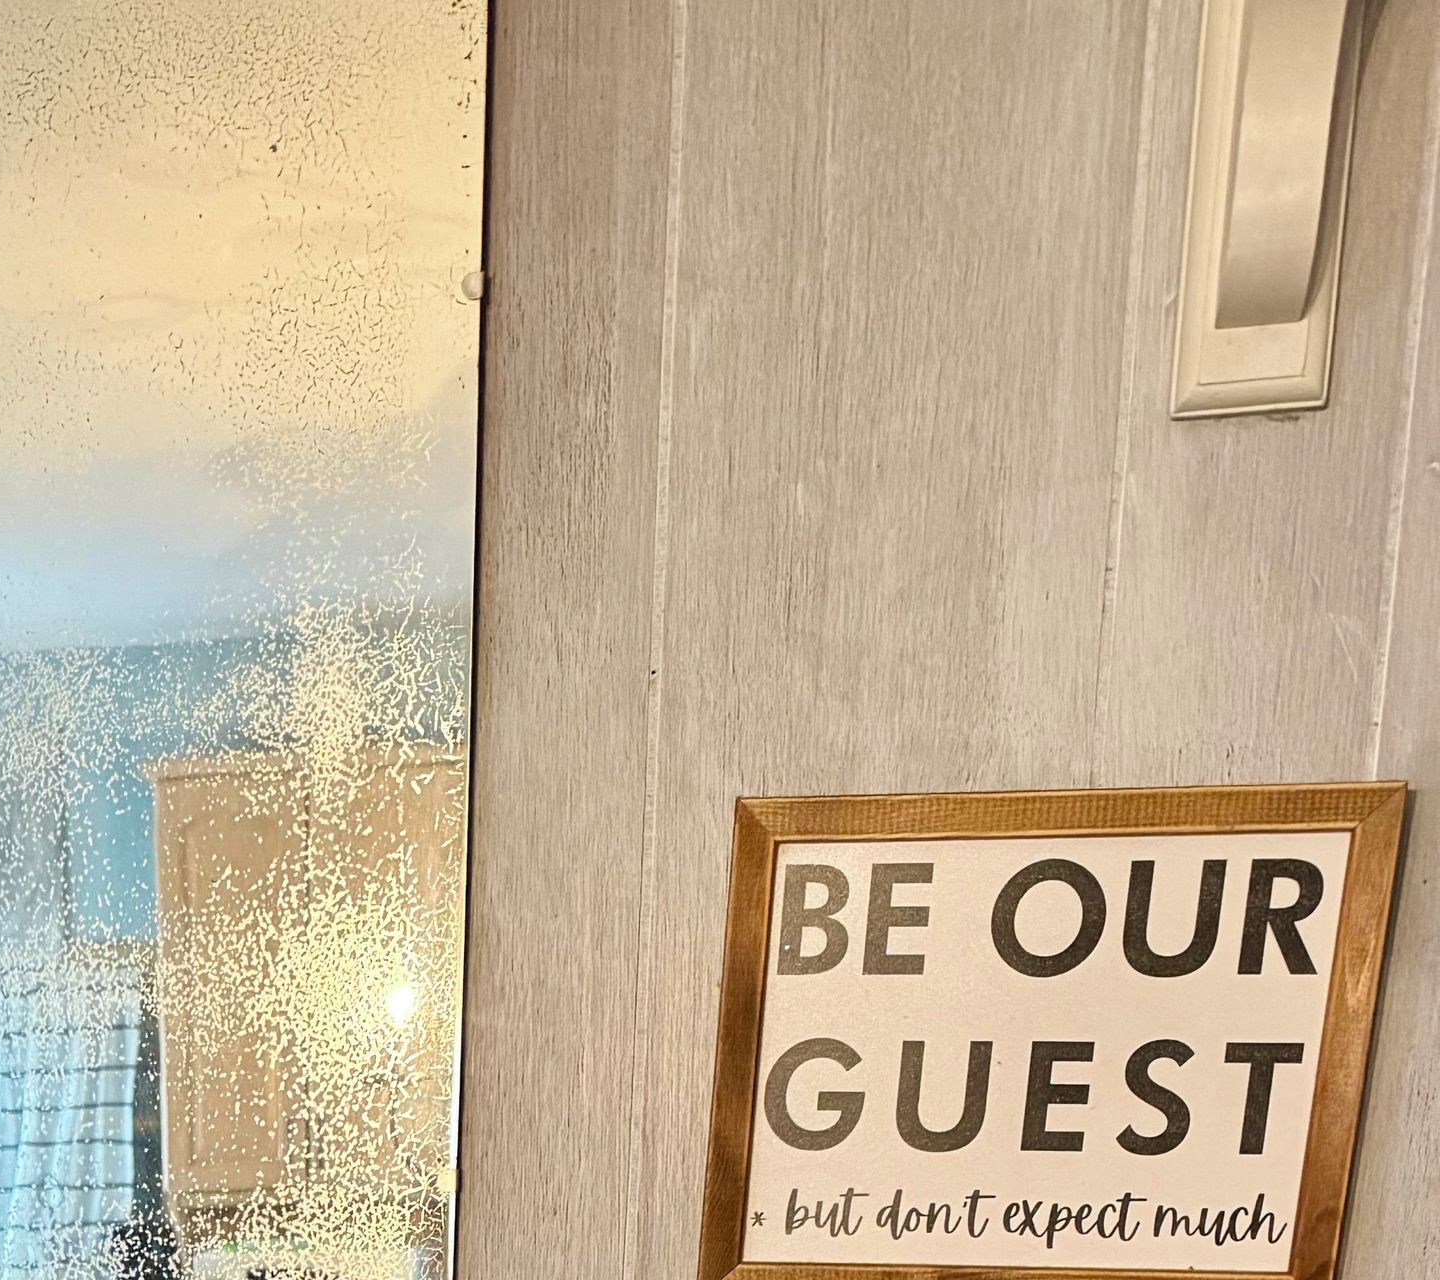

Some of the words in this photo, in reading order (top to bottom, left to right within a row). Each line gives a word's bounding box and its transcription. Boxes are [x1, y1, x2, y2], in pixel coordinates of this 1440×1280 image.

[776, 862, 935, 976] BE
[990, 858, 1325, 978] OUR
[763, 1037, 1305, 1156] GUEST
[785, 1188, 869, 1237] but
[876, 1189, 997, 1240] don't
[1002, 1196, 1147, 1249] expect
[1153, 1193, 1288, 1244] much
